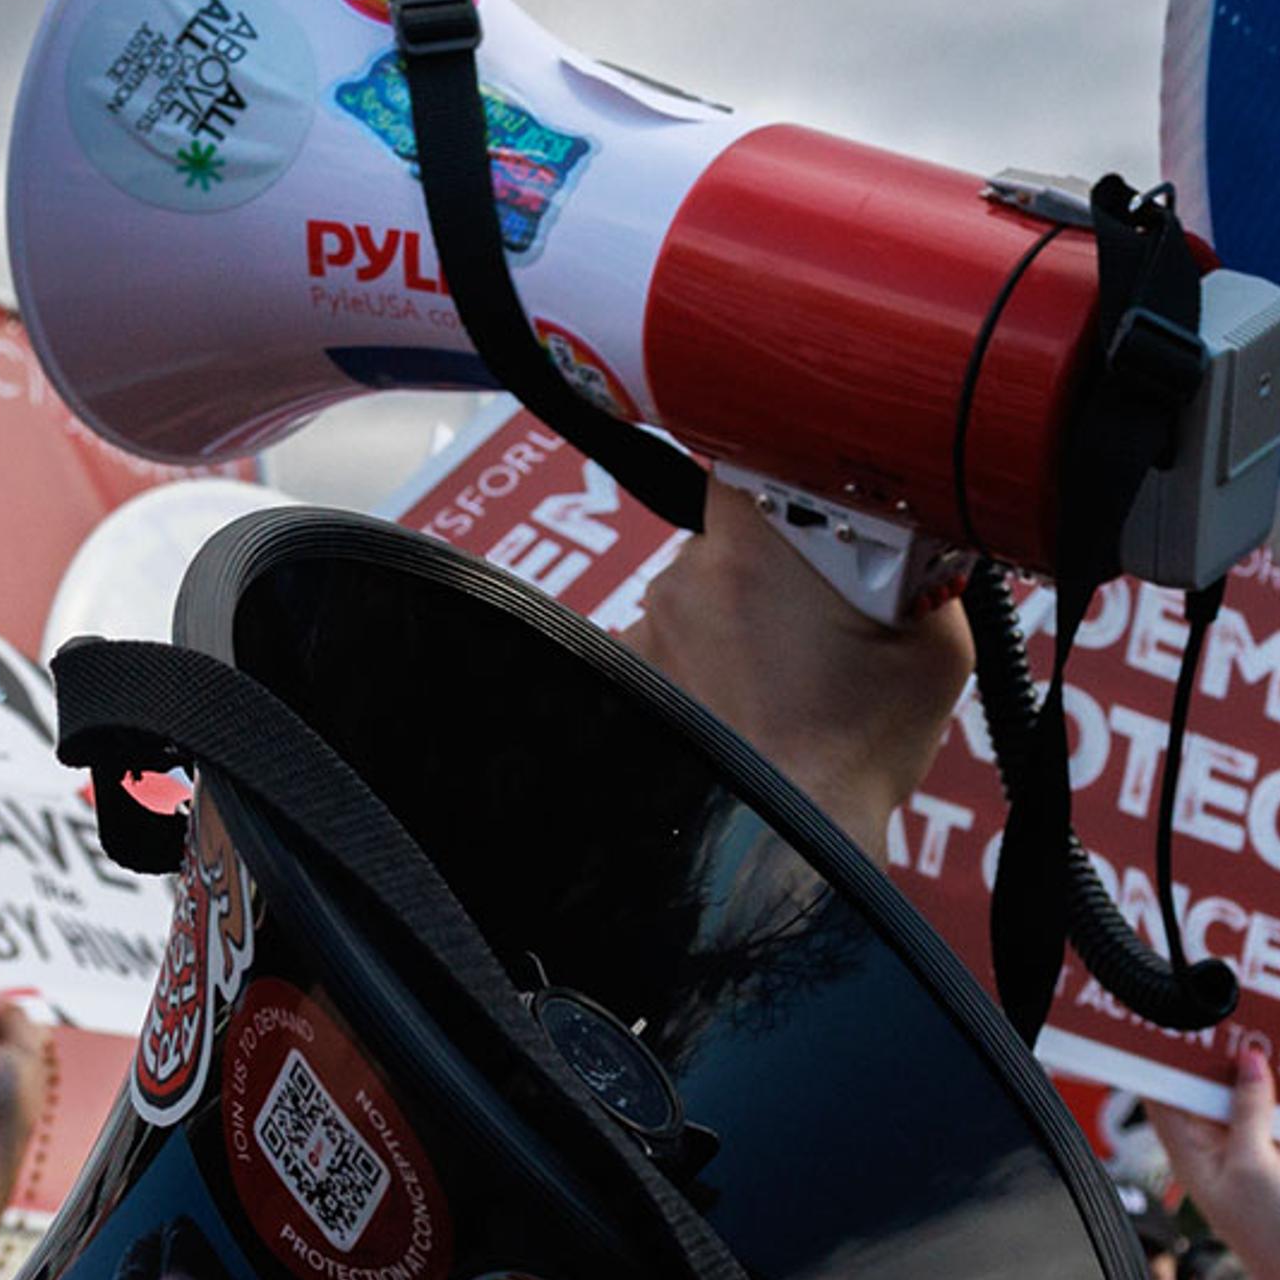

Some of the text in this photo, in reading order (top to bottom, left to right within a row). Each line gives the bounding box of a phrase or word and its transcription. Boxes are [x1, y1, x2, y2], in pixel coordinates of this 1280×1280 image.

[163, 11, 259, 126] ABOVE
[187, 81, 248, 142] ALL
[237, 1027, 259, 1059] TO
[232, 1057, 249, 1096] US
[354, 1087, 434, 1254] CONCEPTION
[402, 1247, 426, 1277] AT
